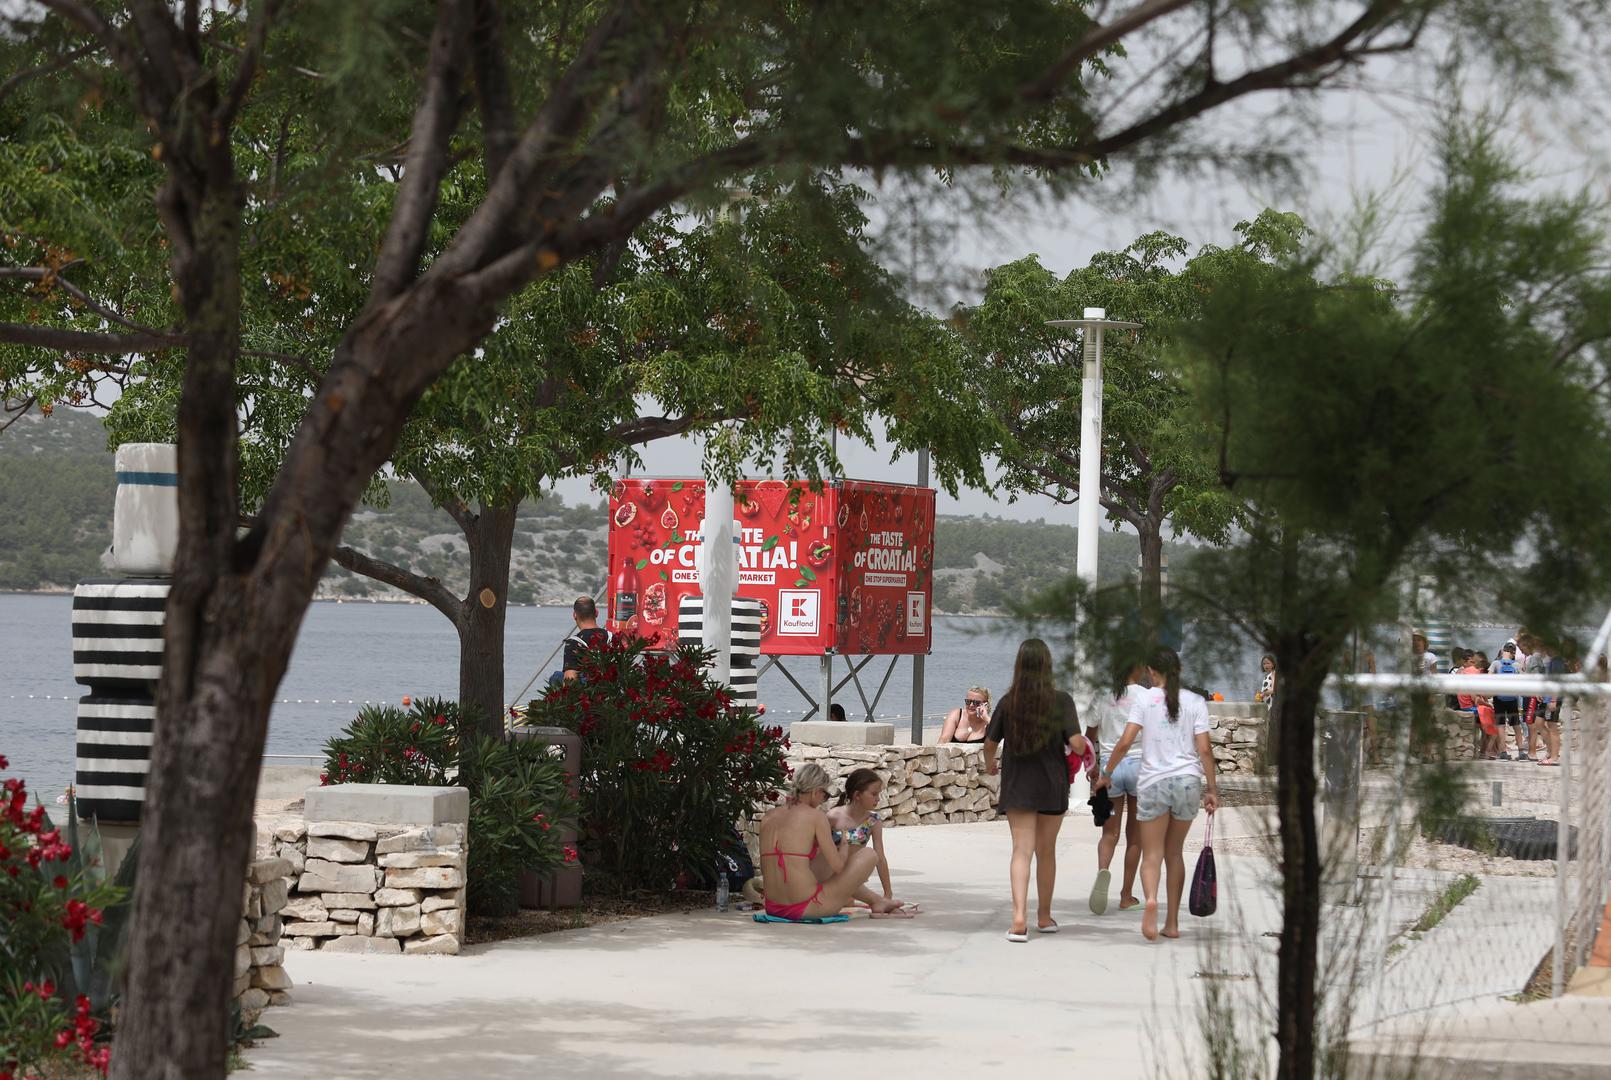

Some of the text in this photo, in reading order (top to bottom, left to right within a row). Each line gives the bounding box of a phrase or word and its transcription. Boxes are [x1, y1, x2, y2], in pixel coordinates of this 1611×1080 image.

[684, 530, 701, 542] TH
[870, 531, 904, 547] THE TASTE
[650, 541, 798, 569] OF CATIA!
[855, 552, 866, 567] OF
[674, 572, 691, 580] ONE
[783, 619, 815, 628] Kaufland
